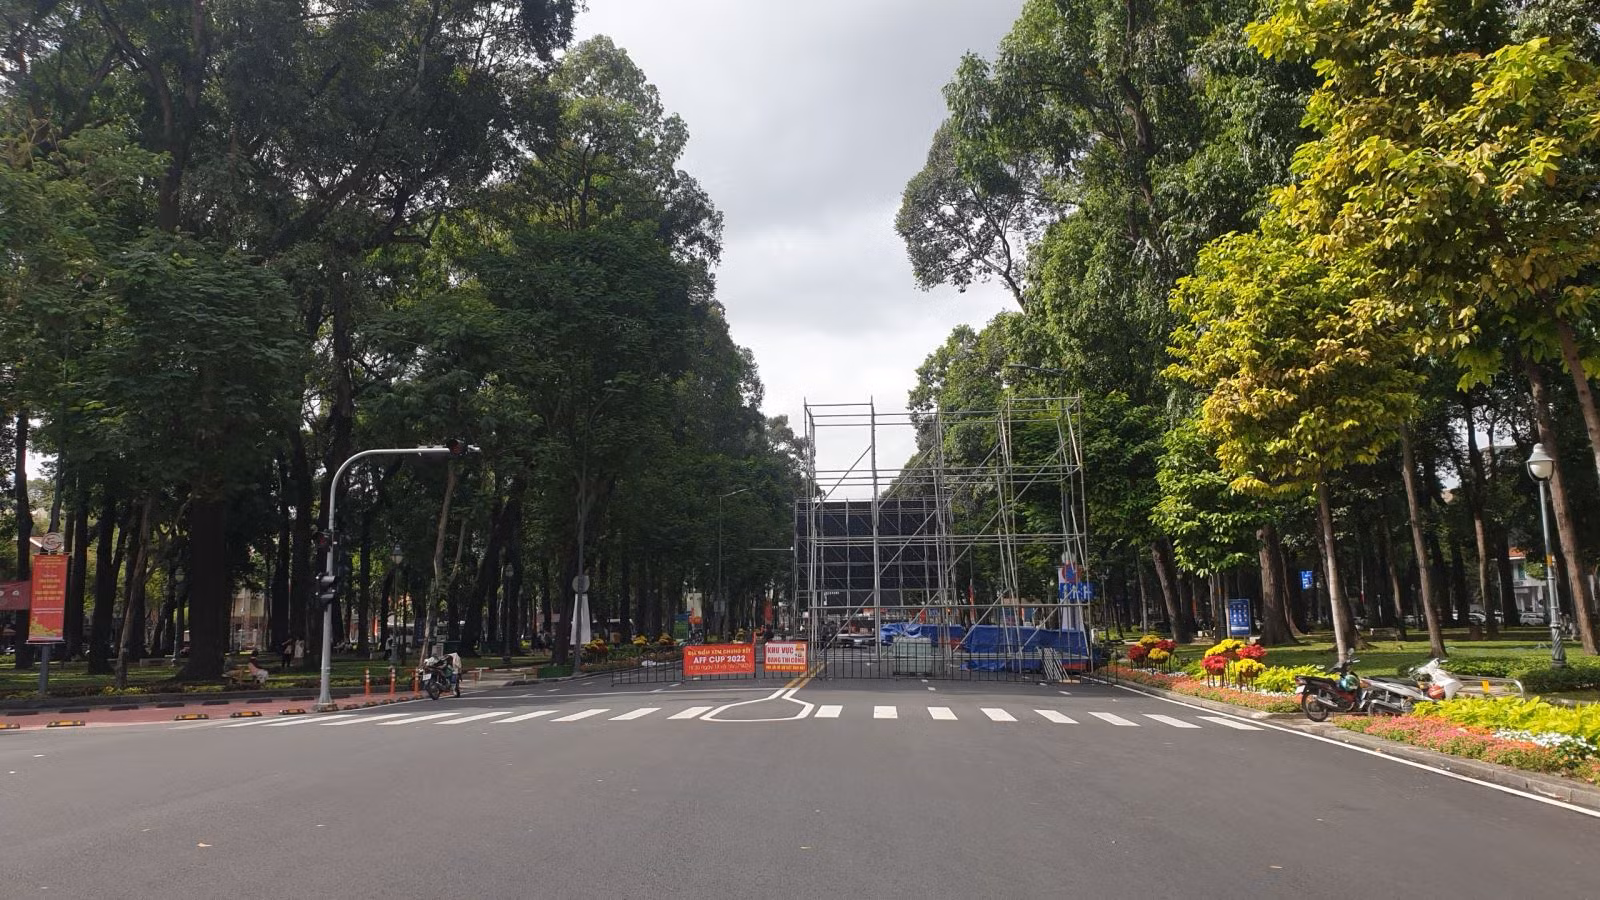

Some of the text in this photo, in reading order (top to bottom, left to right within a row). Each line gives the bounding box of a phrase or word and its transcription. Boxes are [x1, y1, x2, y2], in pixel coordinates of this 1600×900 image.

[767, 646, 794, 655] KHU VỰC
[693, 654, 746, 664] AFF CUP 2022
